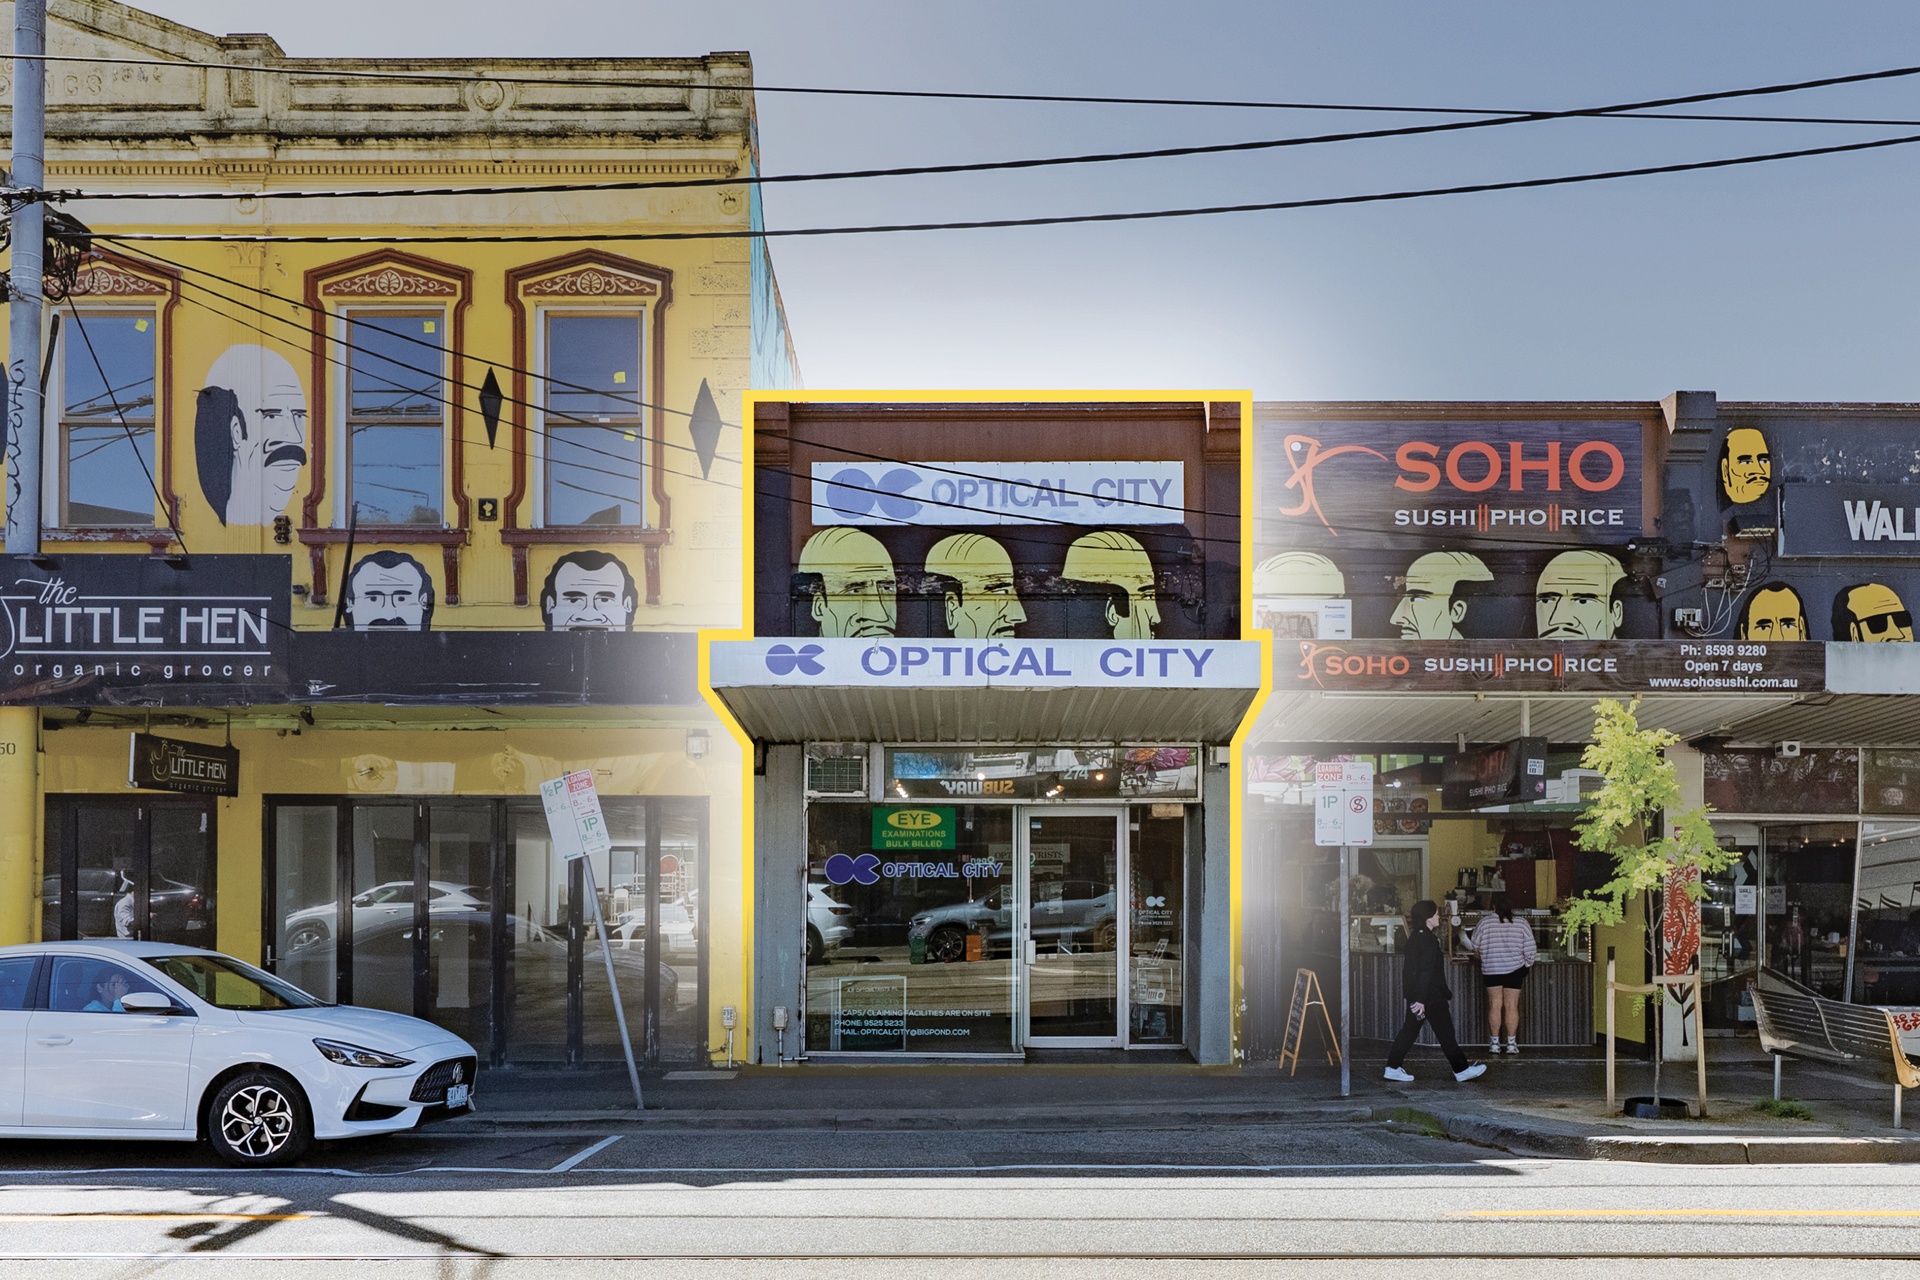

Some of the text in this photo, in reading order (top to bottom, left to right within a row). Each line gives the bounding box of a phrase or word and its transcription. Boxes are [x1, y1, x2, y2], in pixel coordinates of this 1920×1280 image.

[1394, 440, 1625, 492] SOHO
[931, 478, 1173, 508] OPTICAL CITY
[1394, 509, 1624, 526] SUSHI PHO RICE
[1843, 500, 1920, 541] WAL
[15, 577, 77, 605] the
[19, 607, 267, 644] LITTLE HEN
[1680, 645, 1767, 656] Ph: 8598 9280
[861, 645, 1214, 678] OPTICAL CITY
[1325, 655, 1617, 675] SOHO SUSHI PHO RICE
[1684, 660, 1763, 674] Open 7 days
[14, 662, 271, 679] organic grocer
[1649, 676, 1798, 688] www.sohosushi.com.au
[171, 757, 227, 780] LITTLE HEN
[1318, 764, 1342, 772] LOADING
[567, 771, 591, 785] LOADING
[170, 782, 199, 790] organic
[571, 781, 590, 792] ZONE
[1469, 787, 1483, 797] SUSHI
[1484, 785, 1496, 795] PHO
[1322, 795, 1338, 809] 1P
[582, 817, 598, 832] 1P
[897, 813, 932, 826] EYE
[882, 830, 946, 838] EXAMINATIONS
[886, 840, 942, 848] BULK BILLED
[994, 851, 1064, 859] OPTTRISTS
[882, 862, 1003, 878] OPTICAL CITY
[834, 1009, 867, 1017] HCAPS/
[860, 1029, 970, 1037] OPTICALCITY@BIGPOND.COM
